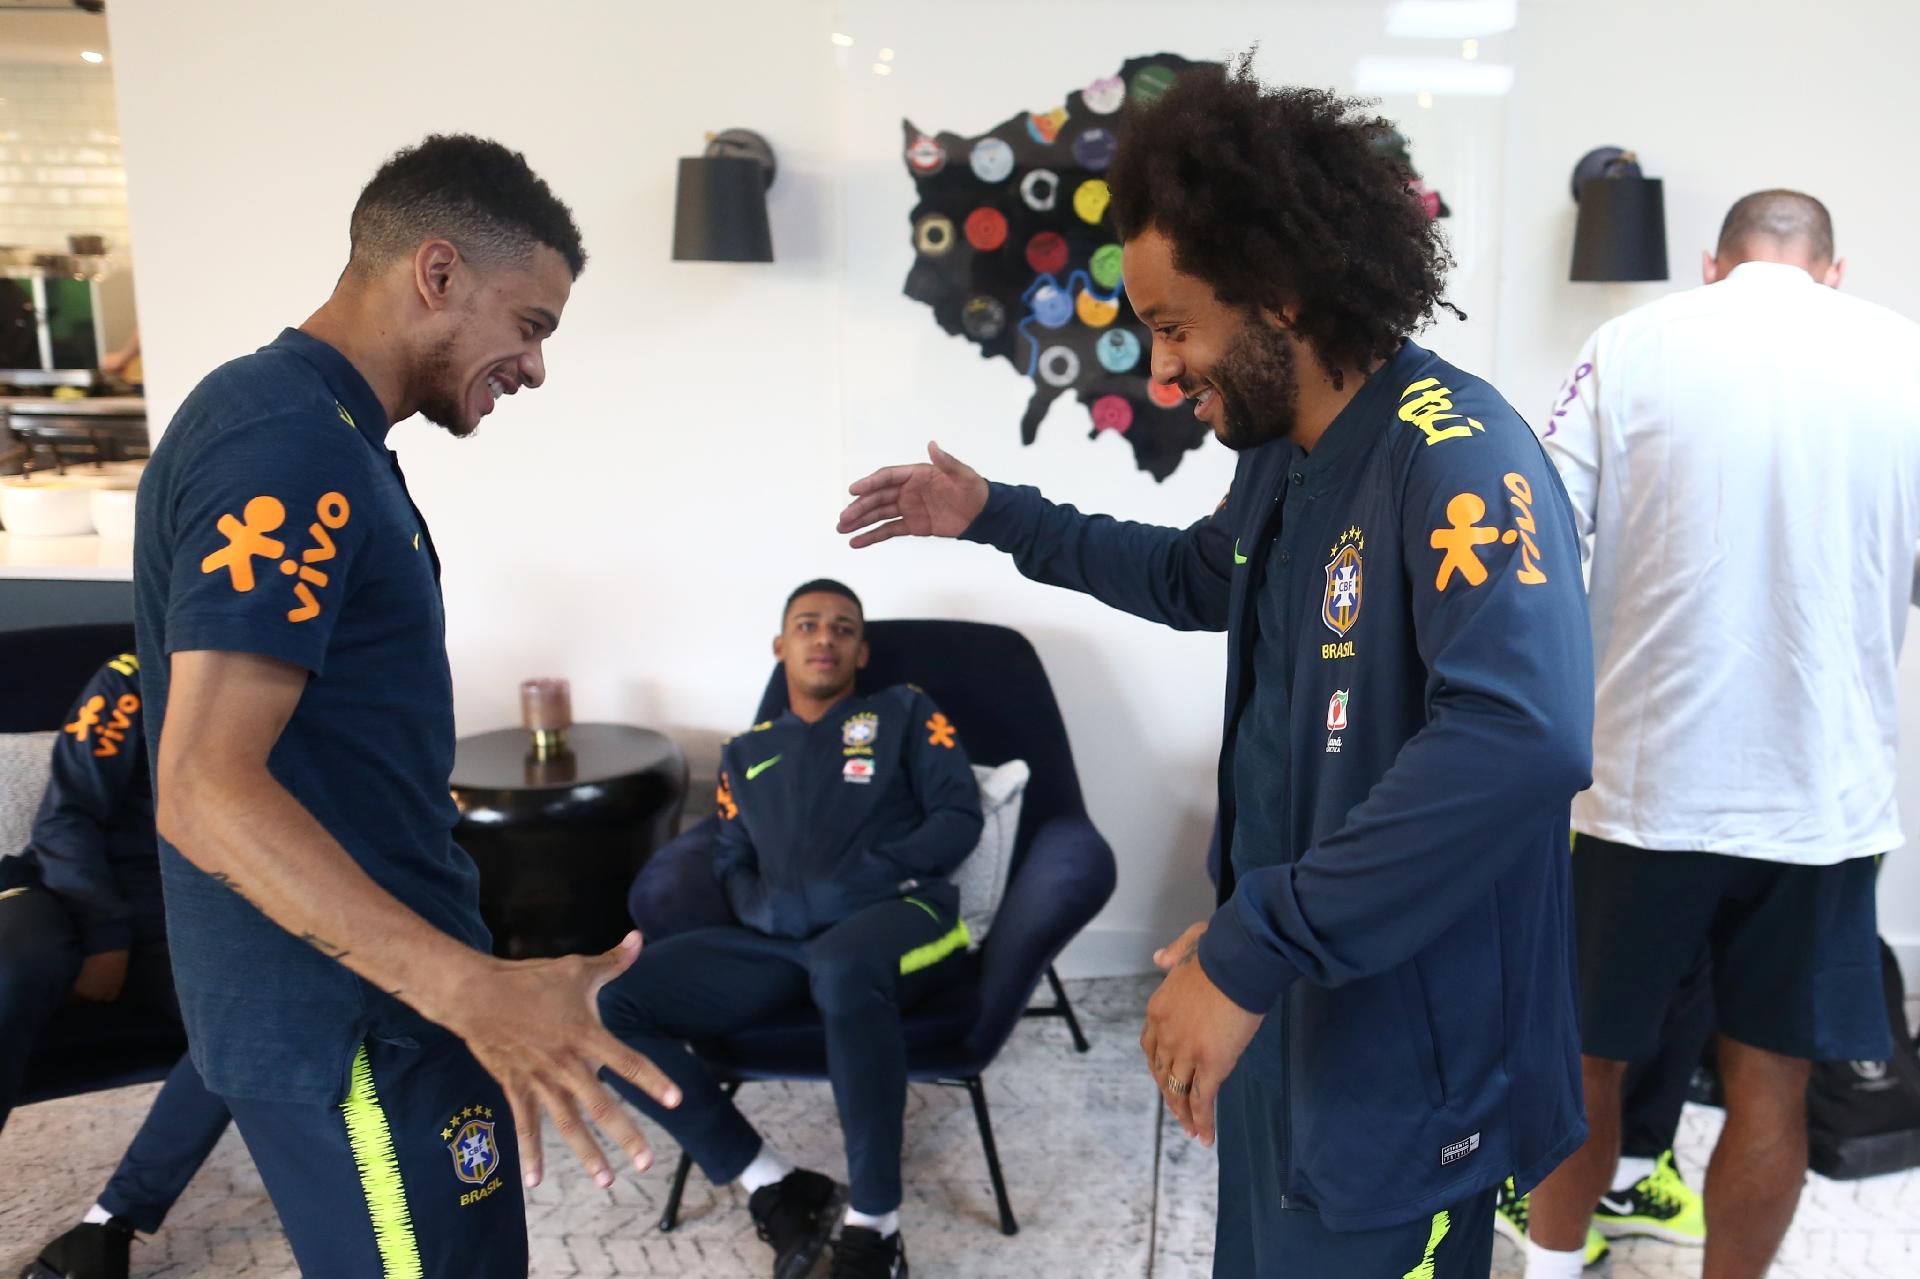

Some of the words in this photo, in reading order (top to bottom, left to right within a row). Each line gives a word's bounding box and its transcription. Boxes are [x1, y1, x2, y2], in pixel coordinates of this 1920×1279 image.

[1502, 472, 1547, 584] vivo
[279, 491, 350, 623] vivo
[1338, 581, 1353, 592] CBF
[1322, 640, 1356, 659] BRASIL
[94, 693, 140, 757] vivo
[468, 1144, 485, 1157] CBF
[460, 1177, 503, 1206] BRASIL
